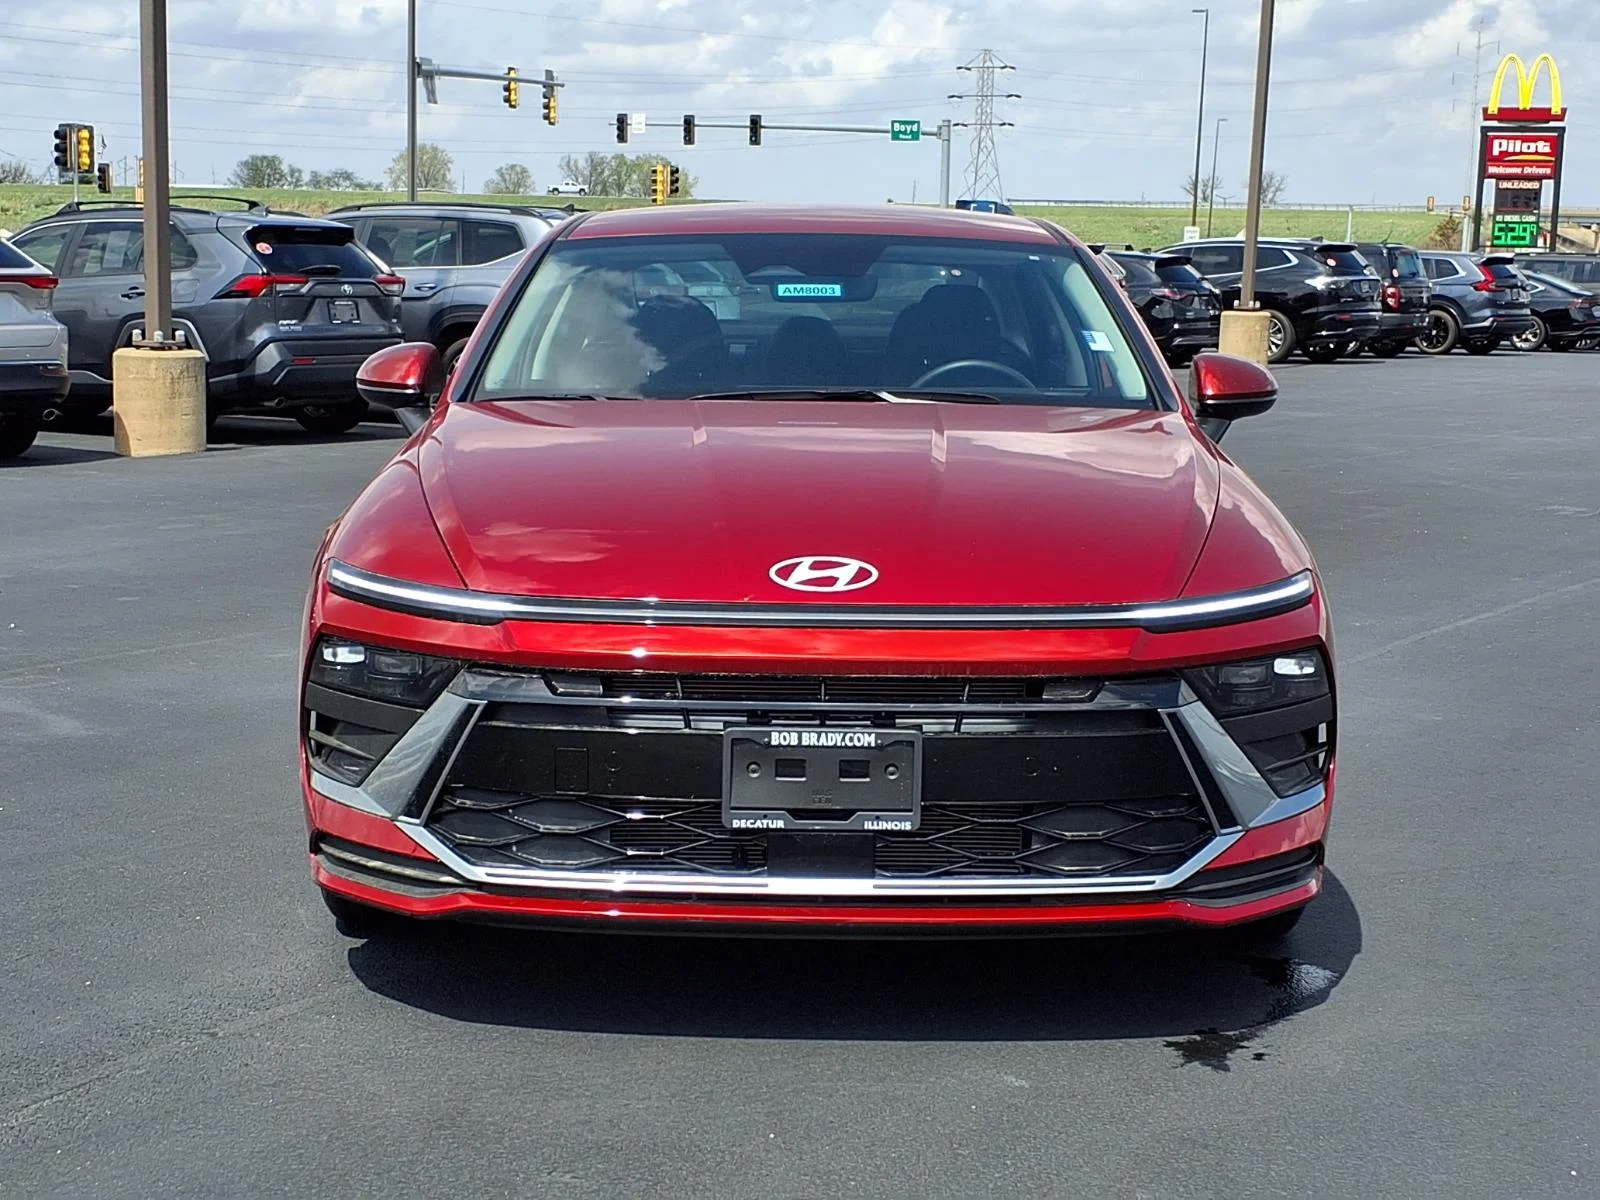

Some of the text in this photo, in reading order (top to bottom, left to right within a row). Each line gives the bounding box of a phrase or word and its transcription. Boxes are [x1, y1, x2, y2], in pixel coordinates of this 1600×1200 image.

[893, 122, 918, 134] Boyd
[1492, 139, 1552, 156] Pilot
[1488, 166, 1552, 174] Welcome Drivers
[1498, 181, 1540, 189] UNLEADED
[782, 286, 836, 295] AM8003
[770, 731, 876, 747] BOB BRADY.COM
[732, 819, 785, 829] DECATUR
[863, 820, 912, 831] ILLINOIS
